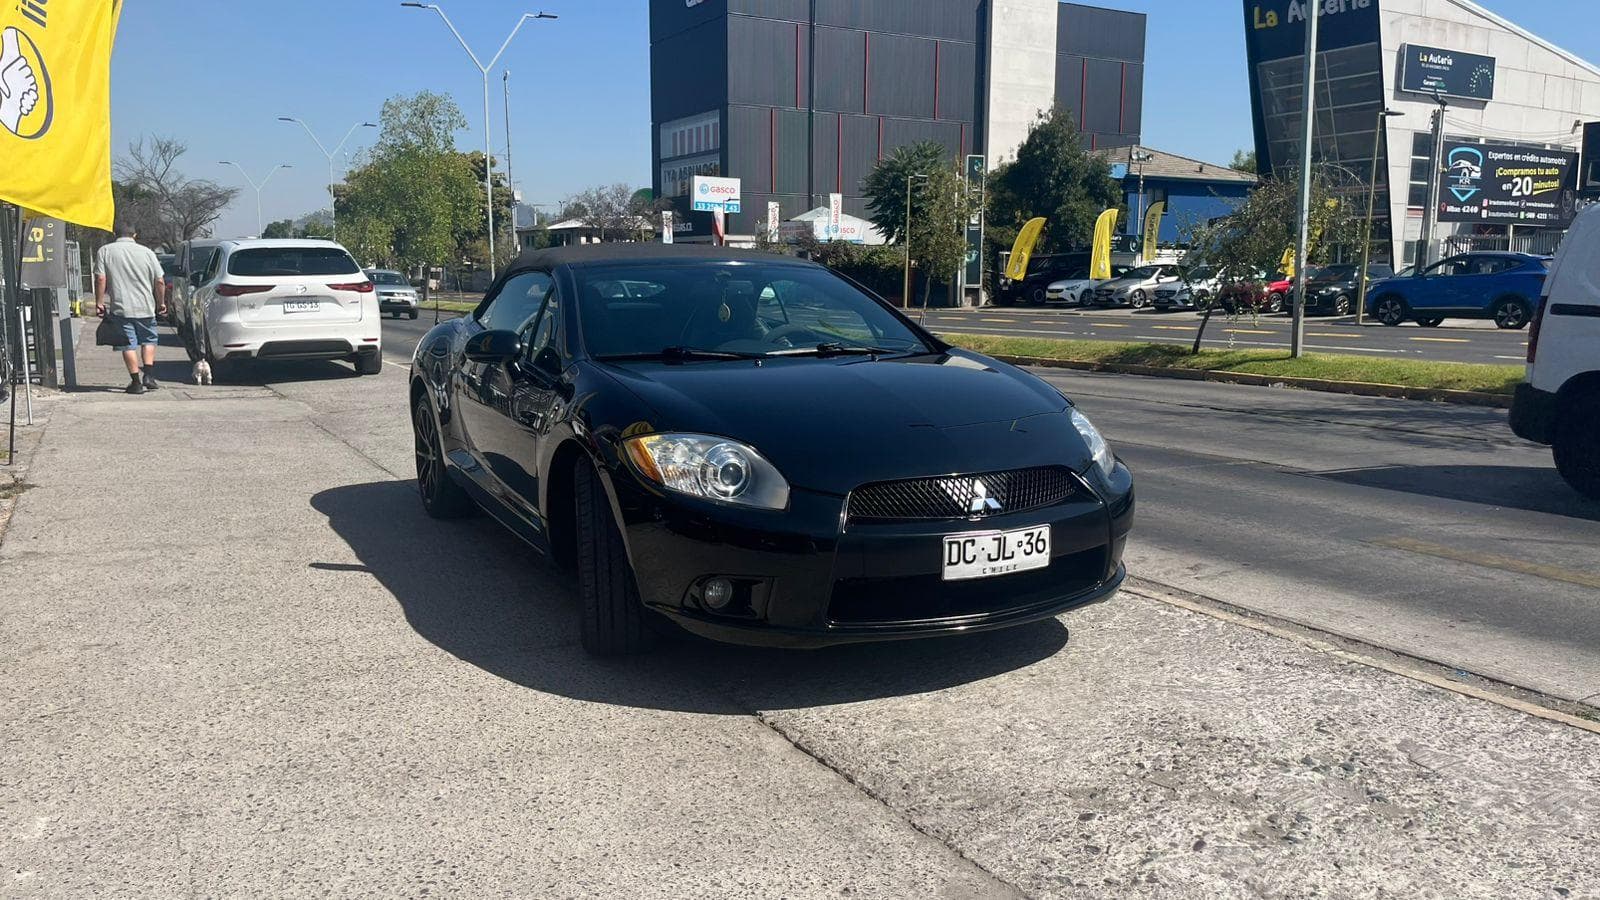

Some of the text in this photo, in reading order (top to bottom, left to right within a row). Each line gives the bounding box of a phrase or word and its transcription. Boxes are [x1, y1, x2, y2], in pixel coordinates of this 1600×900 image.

[1254, 6, 1278, 30] La
[1419, 52, 1427, 62] La
[1488, 151, 1513, 161] Expertos
[1502, 182, 1512, 190] en
[1511, 176, 1532, 196] 20
[22, 227, 45, 263] La
[46, 222, 54, 261] TE LO
